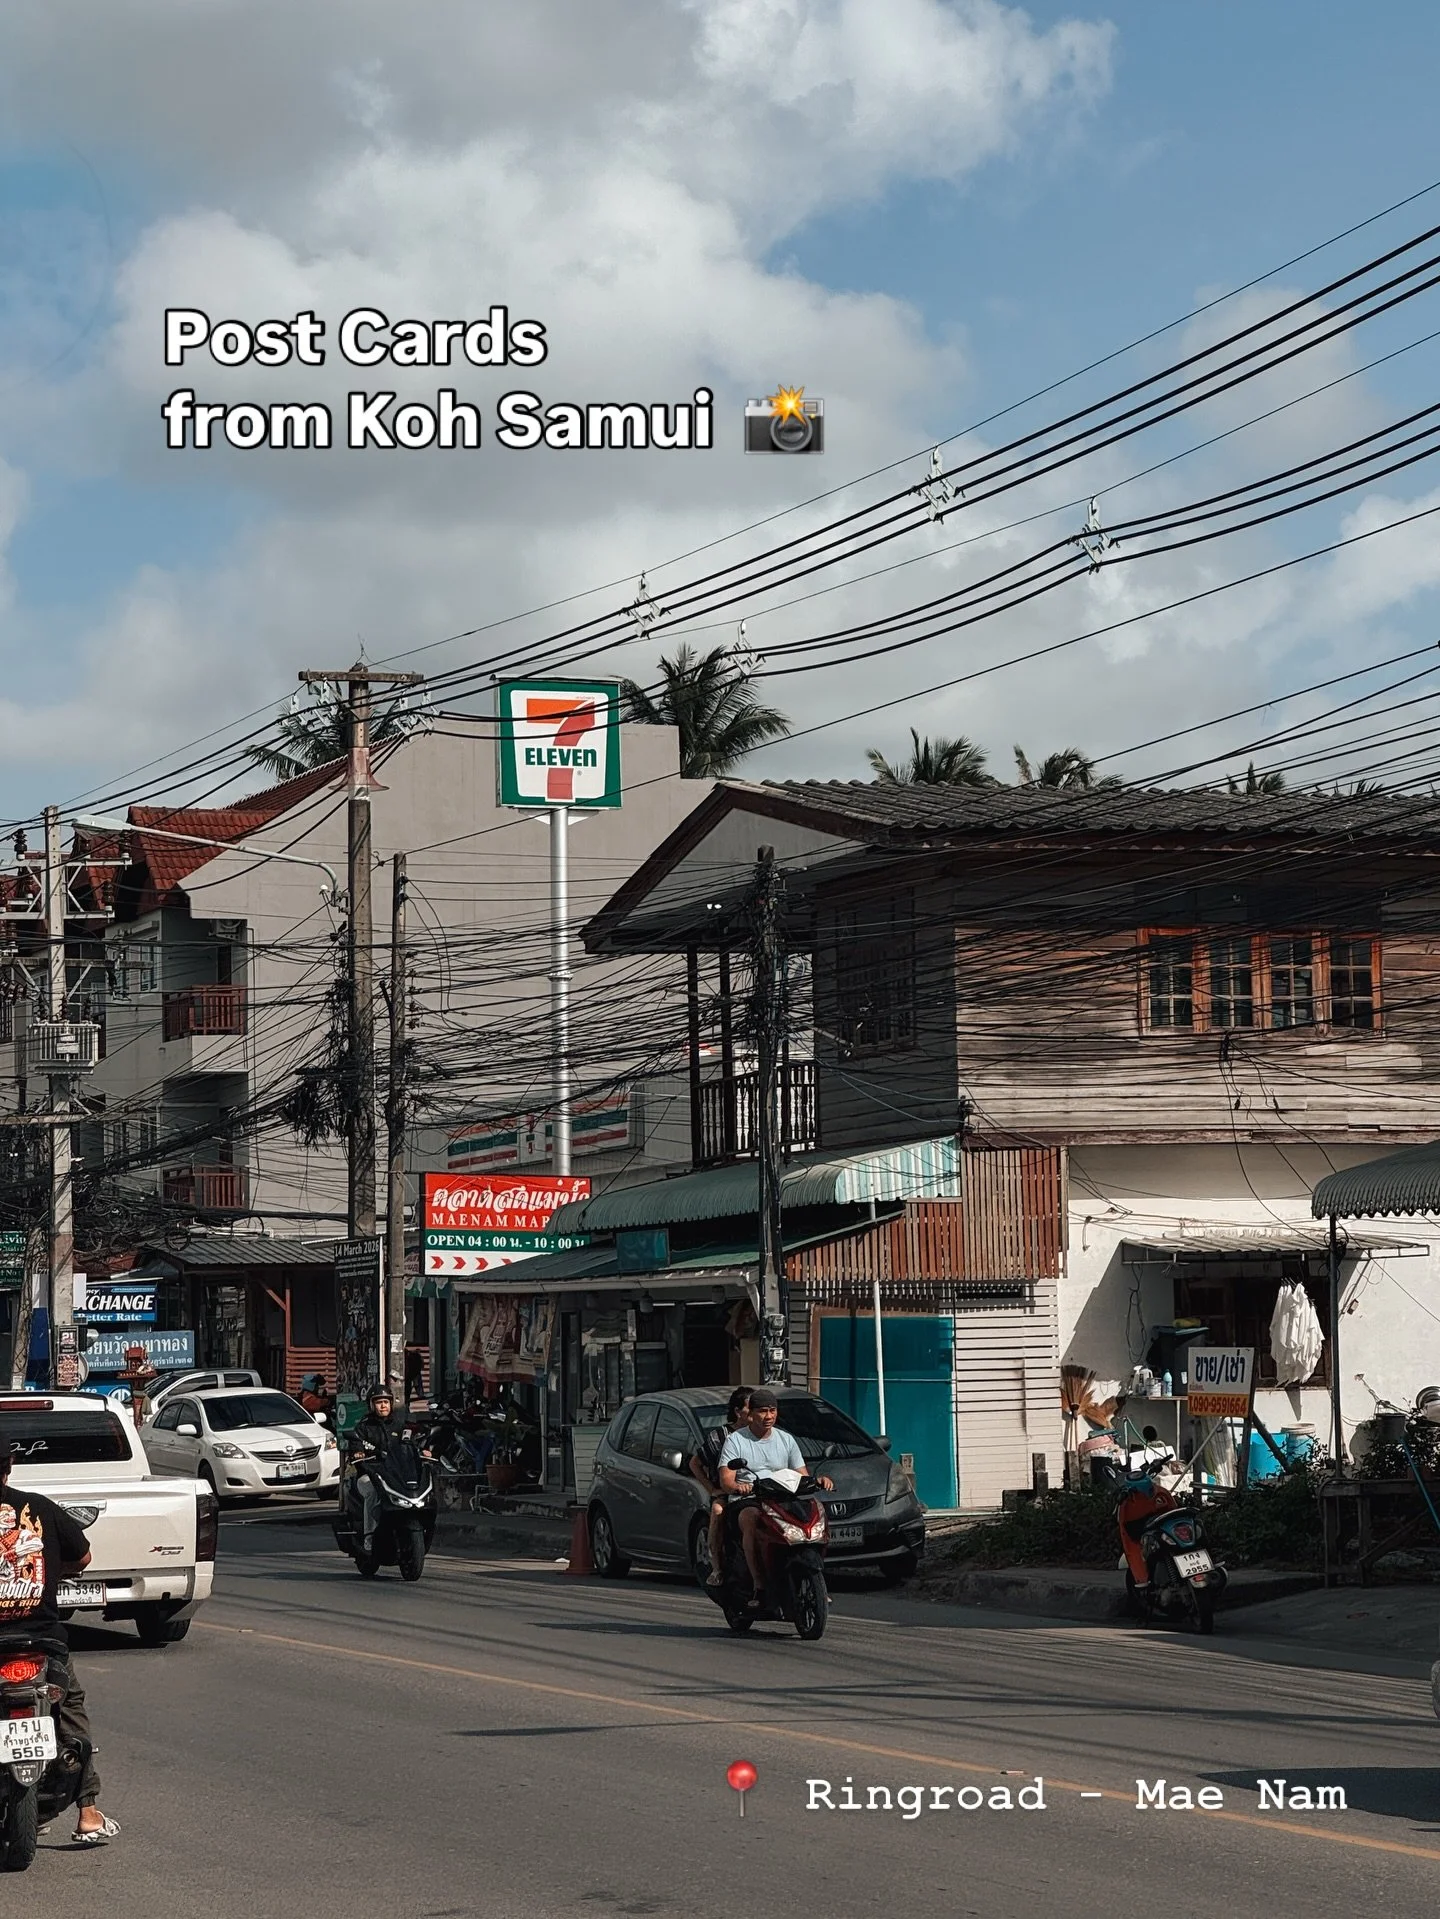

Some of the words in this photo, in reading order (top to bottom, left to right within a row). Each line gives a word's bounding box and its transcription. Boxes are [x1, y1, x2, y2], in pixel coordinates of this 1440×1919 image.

[526, 698, 595, 800] 7
[432, 1212, 508, 1227] MAENAM
[514, 1214, 550, 1228] MAR
[427, 1234, 464, 1247] OPEN
[468, 1235, 482, 1247] 04
[492, 1236, 507, 1248] 00
[534, 1237, 547, 1248] 10
[558, 1238, 572, 1249] 00
[335, 1244, 343, 1257] 14
[343, 1242, 362, 1256] March
[75, 1295, 155, 1310] XCHANGE
[116, 1312, 142, 1322] Rate
[1185, 1564, 1209, 1576] 2955
[75, 1583, 101, 1595] 5349
[12, 1746, 44, 1760] 556
